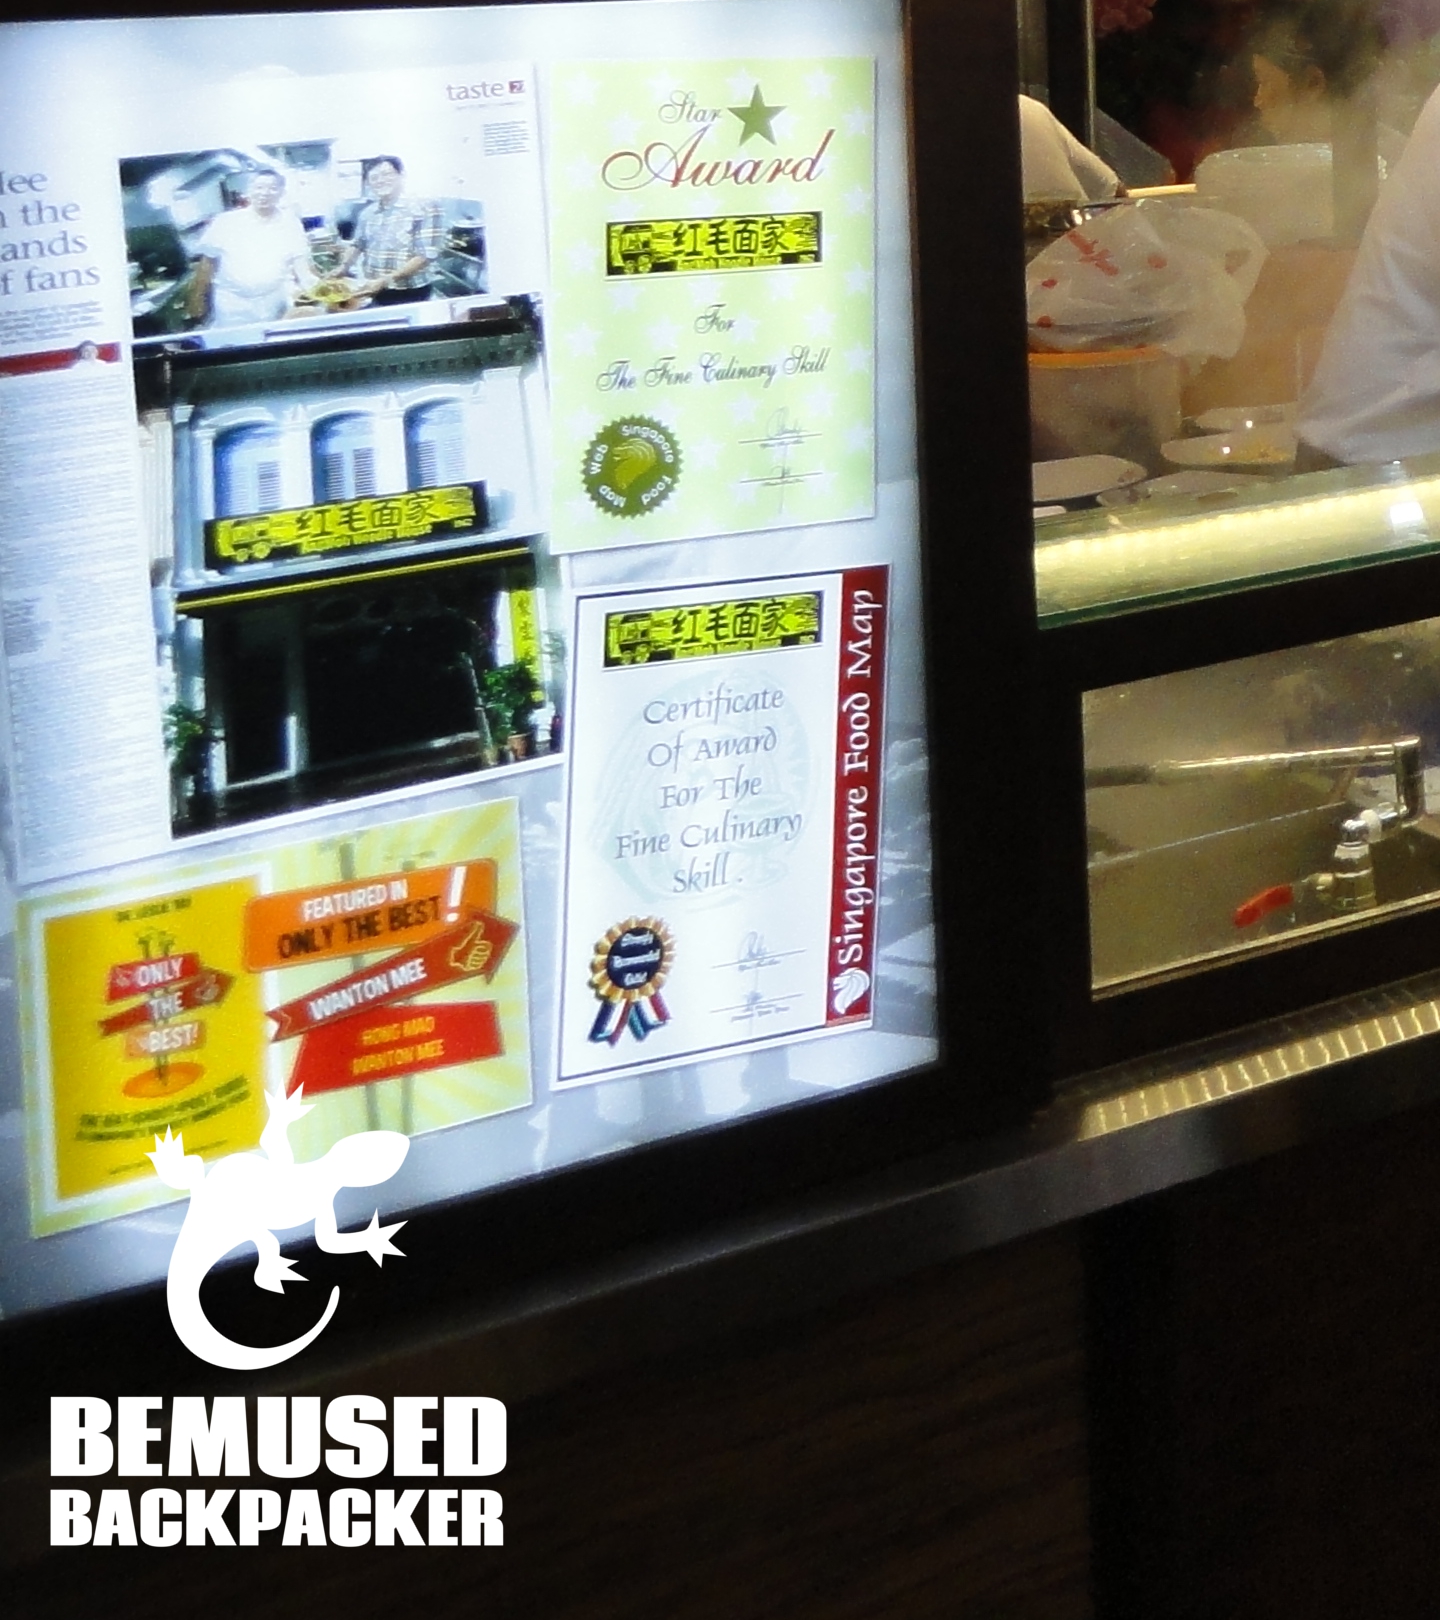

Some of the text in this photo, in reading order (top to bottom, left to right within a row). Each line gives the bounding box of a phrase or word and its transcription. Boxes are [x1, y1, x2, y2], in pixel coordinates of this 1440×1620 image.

[446, 81, 505, 101] taste
[658, 90, 723, 125] Star
[602, 123, 836, 191] Award
[22, 200, 81, 226] the
[672, 215, 790, 258] 红毛面家
[25, 266, 101, 293] fans
[694, 303, 736, 335] For
[596, 344, 832, 392] The Fine Culinary Skill
[672, 598, 791, 645] 红毛面家
[643, 682, 785, 726] Certificate
[647, 726, 778, 774] Of Award
[659, 763, 763, 810] For The
[837, 587, 884, 966] Singapore Food Map
[614, 808, 804, 860] Fine Culinary
[302, 883, 387, 923] FEATURED
[278, 924, 334, 960] ONLY
[344, 909, 382, 945] THE
[387, 895, 441, 931] BEST
[134, 956, 184, 988] ONLY
[308, 956, 428, 1022] WANTON MEE
[149, 990, 184, 1020] THE
[148, 1021, 200, 1053] BEST!
